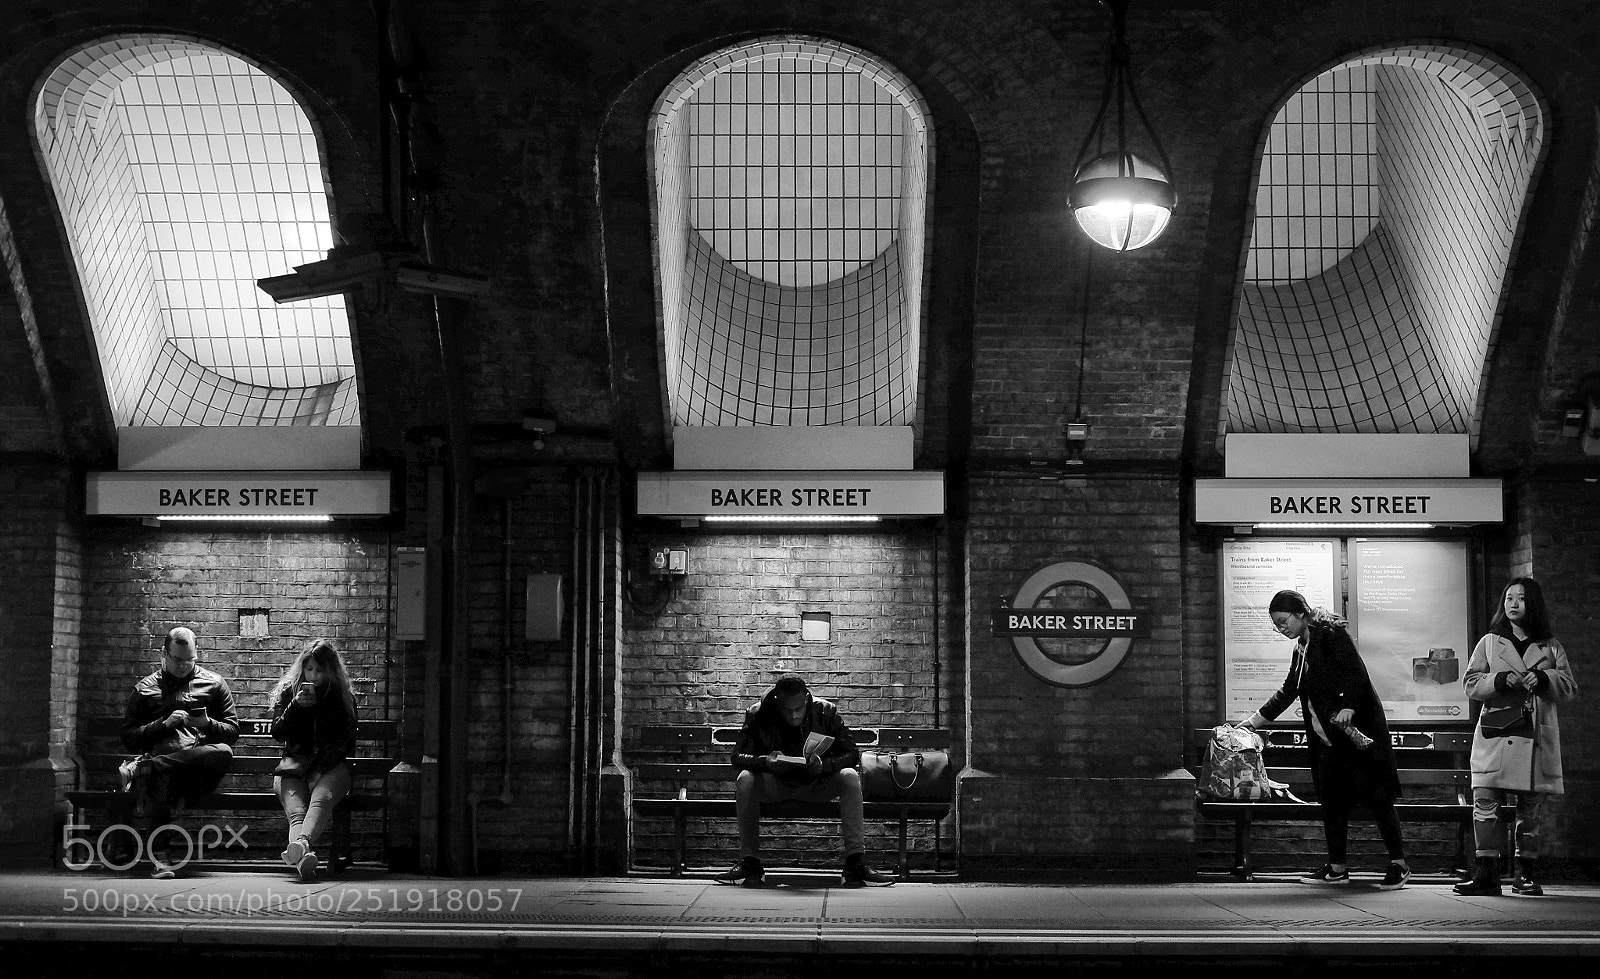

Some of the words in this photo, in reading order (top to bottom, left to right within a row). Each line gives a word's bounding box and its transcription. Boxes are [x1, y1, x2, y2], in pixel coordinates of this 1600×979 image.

[159, 488, 231, 506] BAKER
[238, 488, 319, 506] STREET
[711, 488, 784, 506] BAKER
[790, 488, 872, 506] STREET
[1270, 496, 1343, 514] BAKER
[1350, 495, 1431, 514] STREET
[1008, 615, 1067, 629] BAKER
[1072, 616, 1137, 630] STREET
[253, 722, 273, 733] STR
